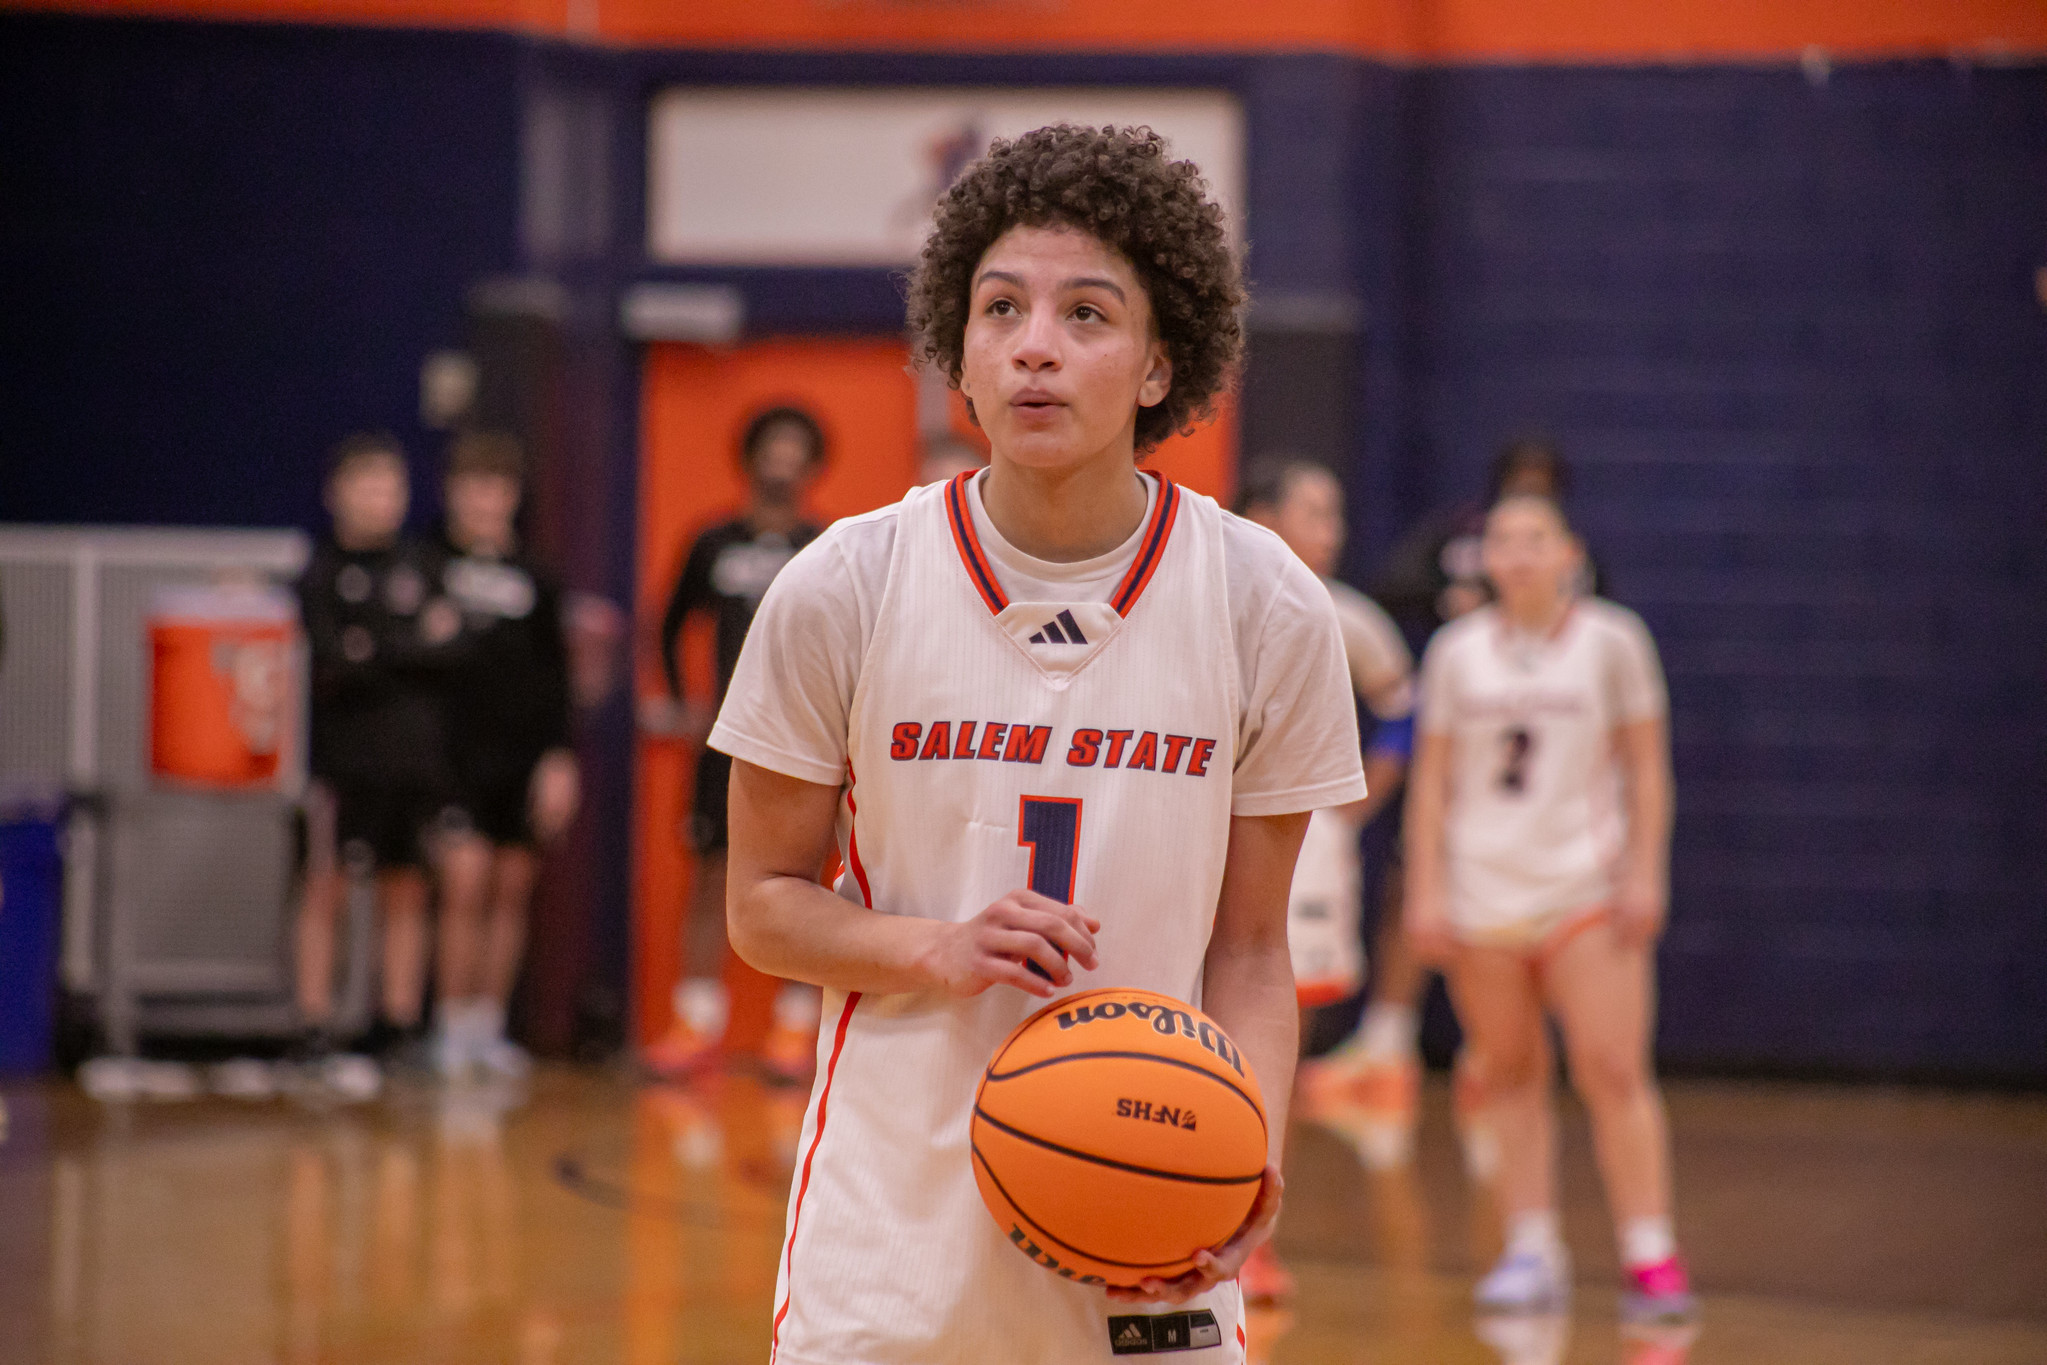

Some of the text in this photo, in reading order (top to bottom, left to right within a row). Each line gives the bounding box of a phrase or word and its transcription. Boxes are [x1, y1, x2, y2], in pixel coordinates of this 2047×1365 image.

[890, 721, 1217, 777] SALEM STATE
[1017, 794, 1083, 982] 1
[1055, 1001, 1245, 1079] Wilson
[1116, 1097, 1181, 1127] NFHS
[1167, 1328, 1177, 1343] M
